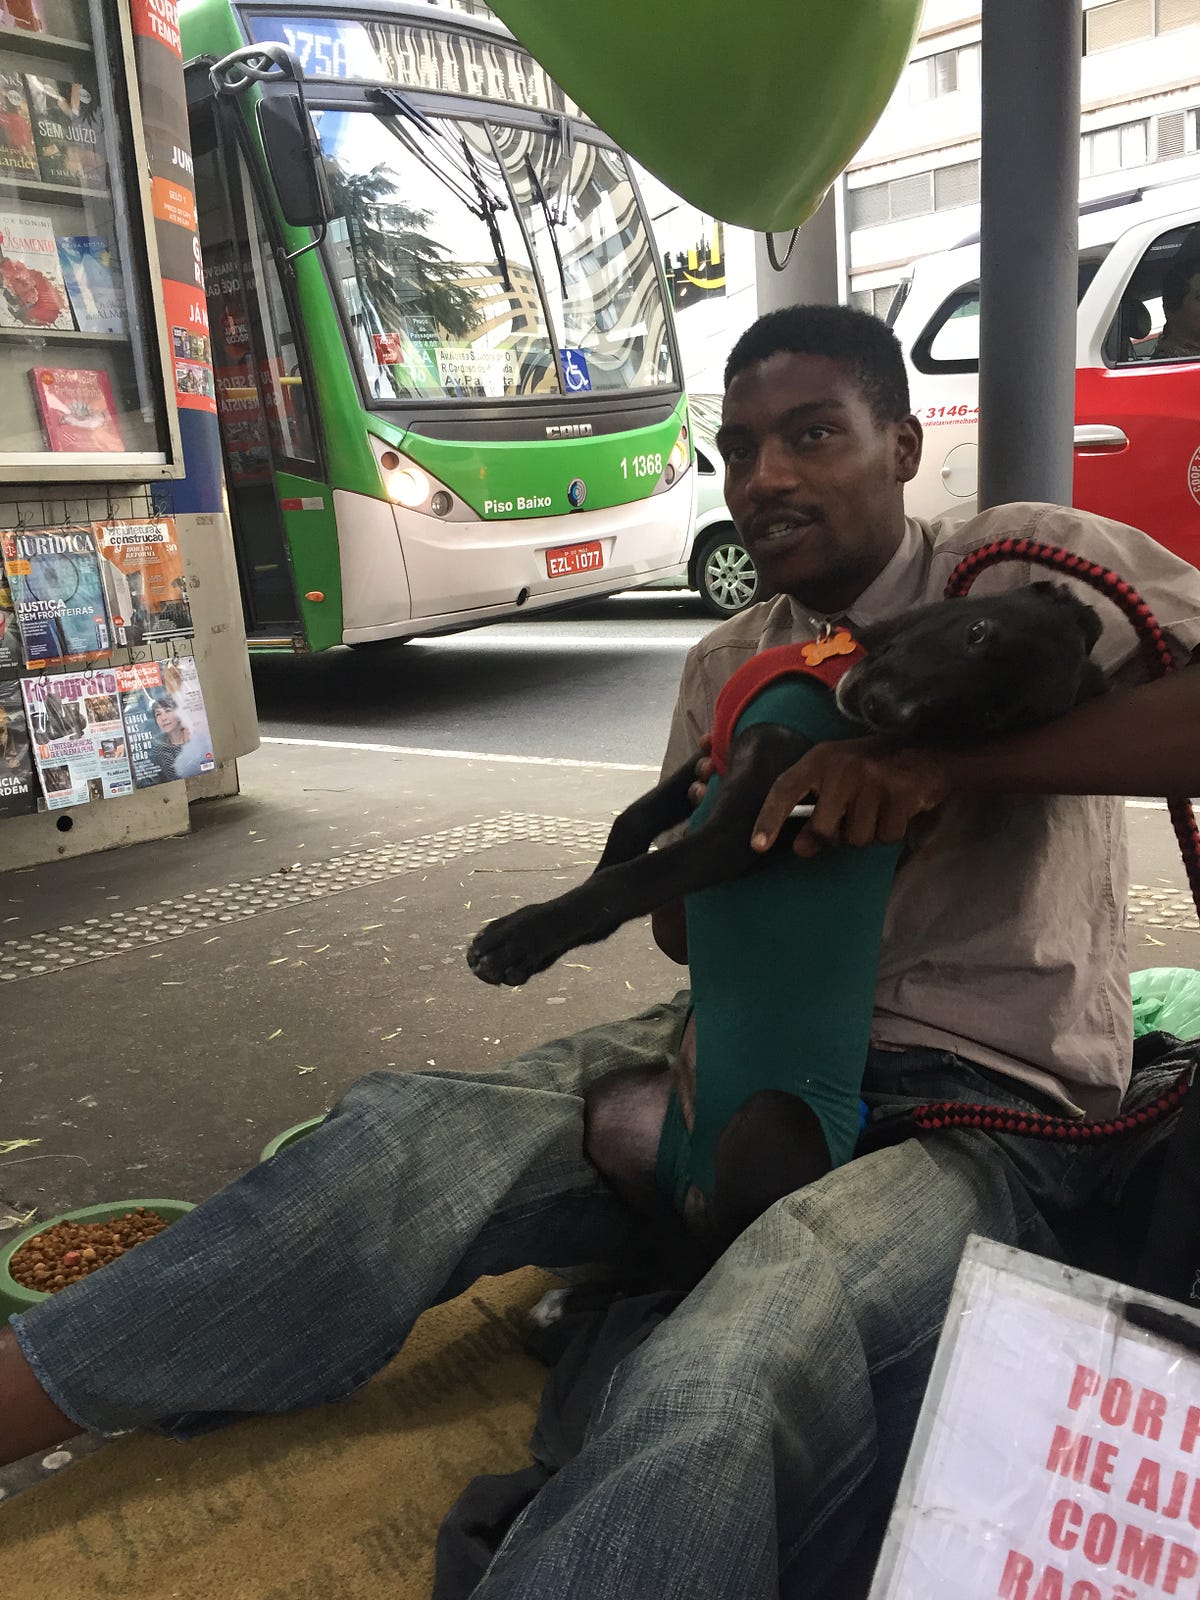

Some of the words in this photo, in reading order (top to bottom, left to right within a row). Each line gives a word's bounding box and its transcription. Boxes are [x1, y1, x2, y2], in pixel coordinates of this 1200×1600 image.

[38, 120, 64, 139] SEM
[620, 457, 628, 479] 1
[632, 453, 663, 478] 1368
[484, 499, 513, 514] Piso
[517, 496, 552, 511] Baixo
[18, 598, 67, 614] JUSTIÇA
[19, 610, 40, 622] SEM
[40, 606, 95, 619] FRONTEIRAS
[0, 776, 21, 788] CIA
[1067, 1364, 1168, 1442] POR
[1046, 1425, 1120, 1494] ME
